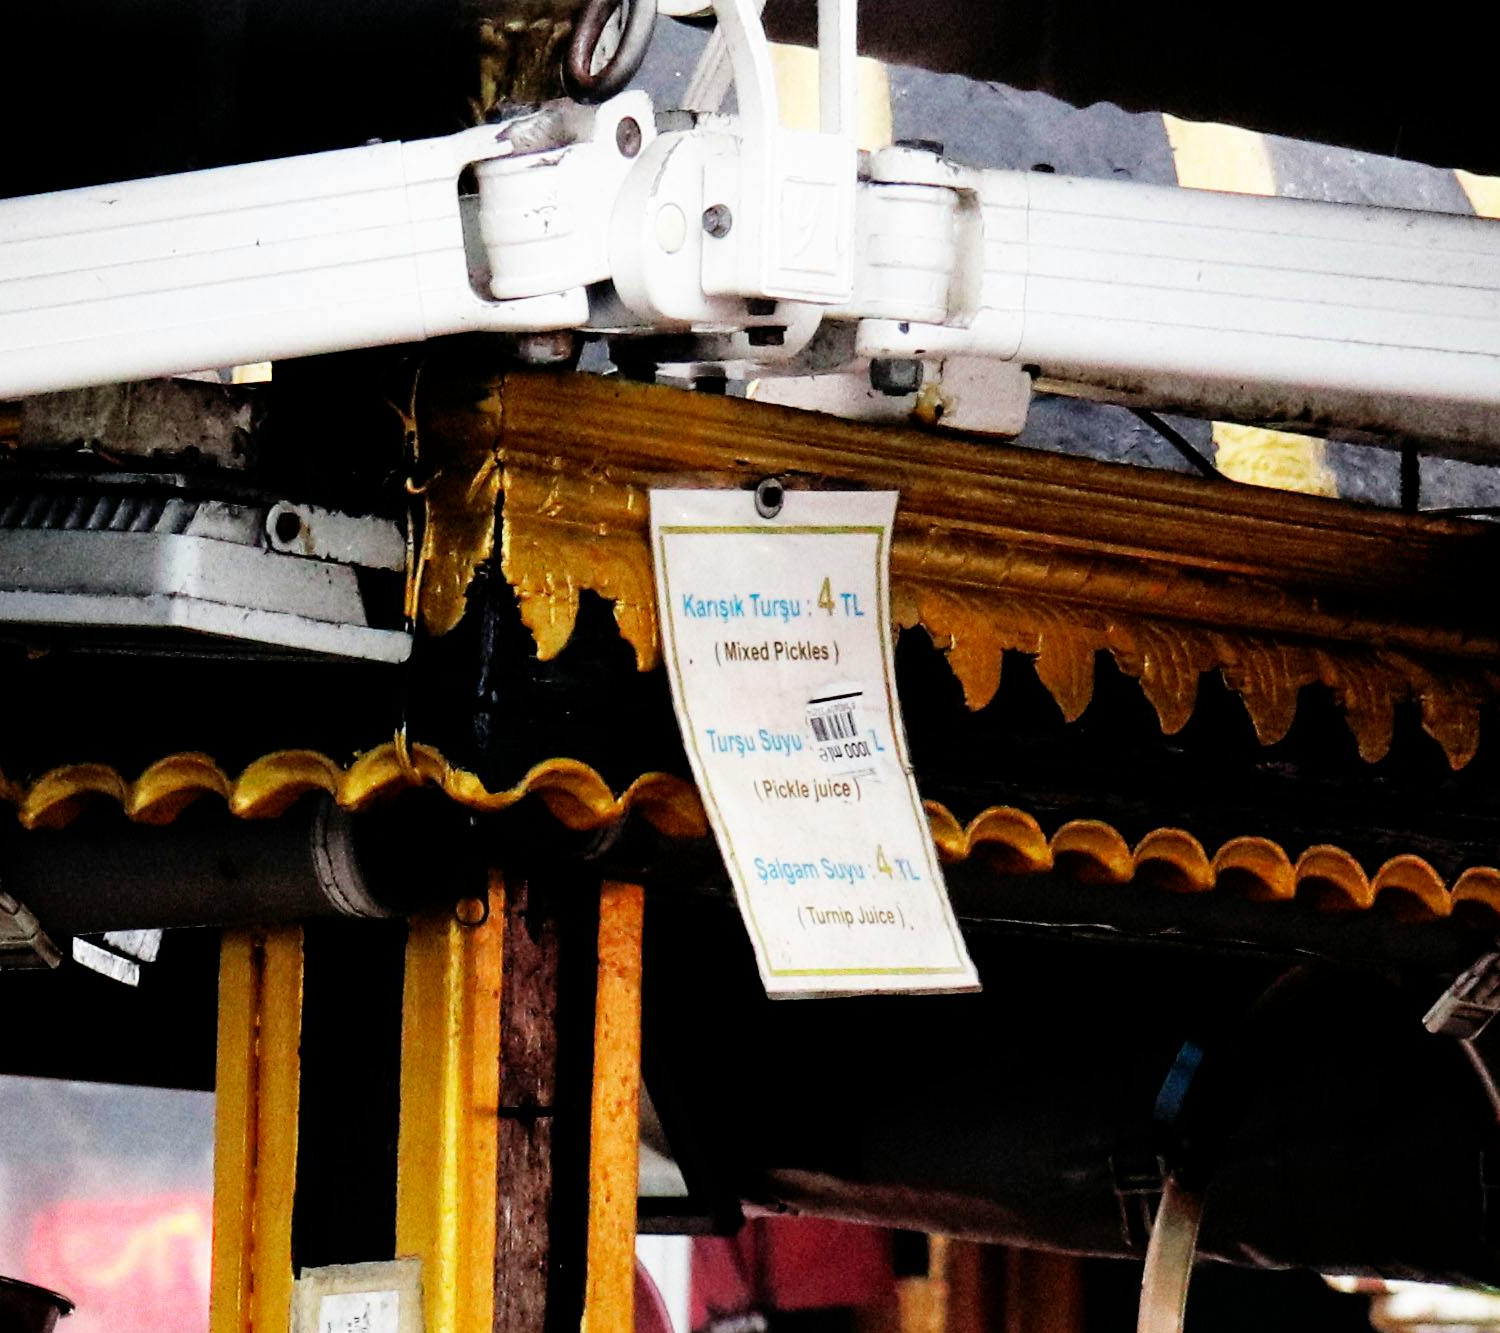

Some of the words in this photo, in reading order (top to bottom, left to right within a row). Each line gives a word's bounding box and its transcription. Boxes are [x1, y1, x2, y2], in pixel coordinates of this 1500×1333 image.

[683, 593, 744, 623] Karışık
[749, 593, 800, 624] Turşu
[817, 577, 836, 617] 4
[840, 592, 864, 617] TL
[724, 641, 769, 661] Mixed
[774, 640, 829, 661] Pickles
[706, 728, 756, 758] Turşu
[758, 729, 803, 756] Suyu
[763, 778, 809, 799] Pickle
[813, 778, 851, 802] juice
[820, 857, 866, 885] Suyu
[876, 844, 893, 879] 4
[895, 859, 921, 880] TL
[805, 906, 853, 928] Turnip
[858, 905, 895, 925] Juice
